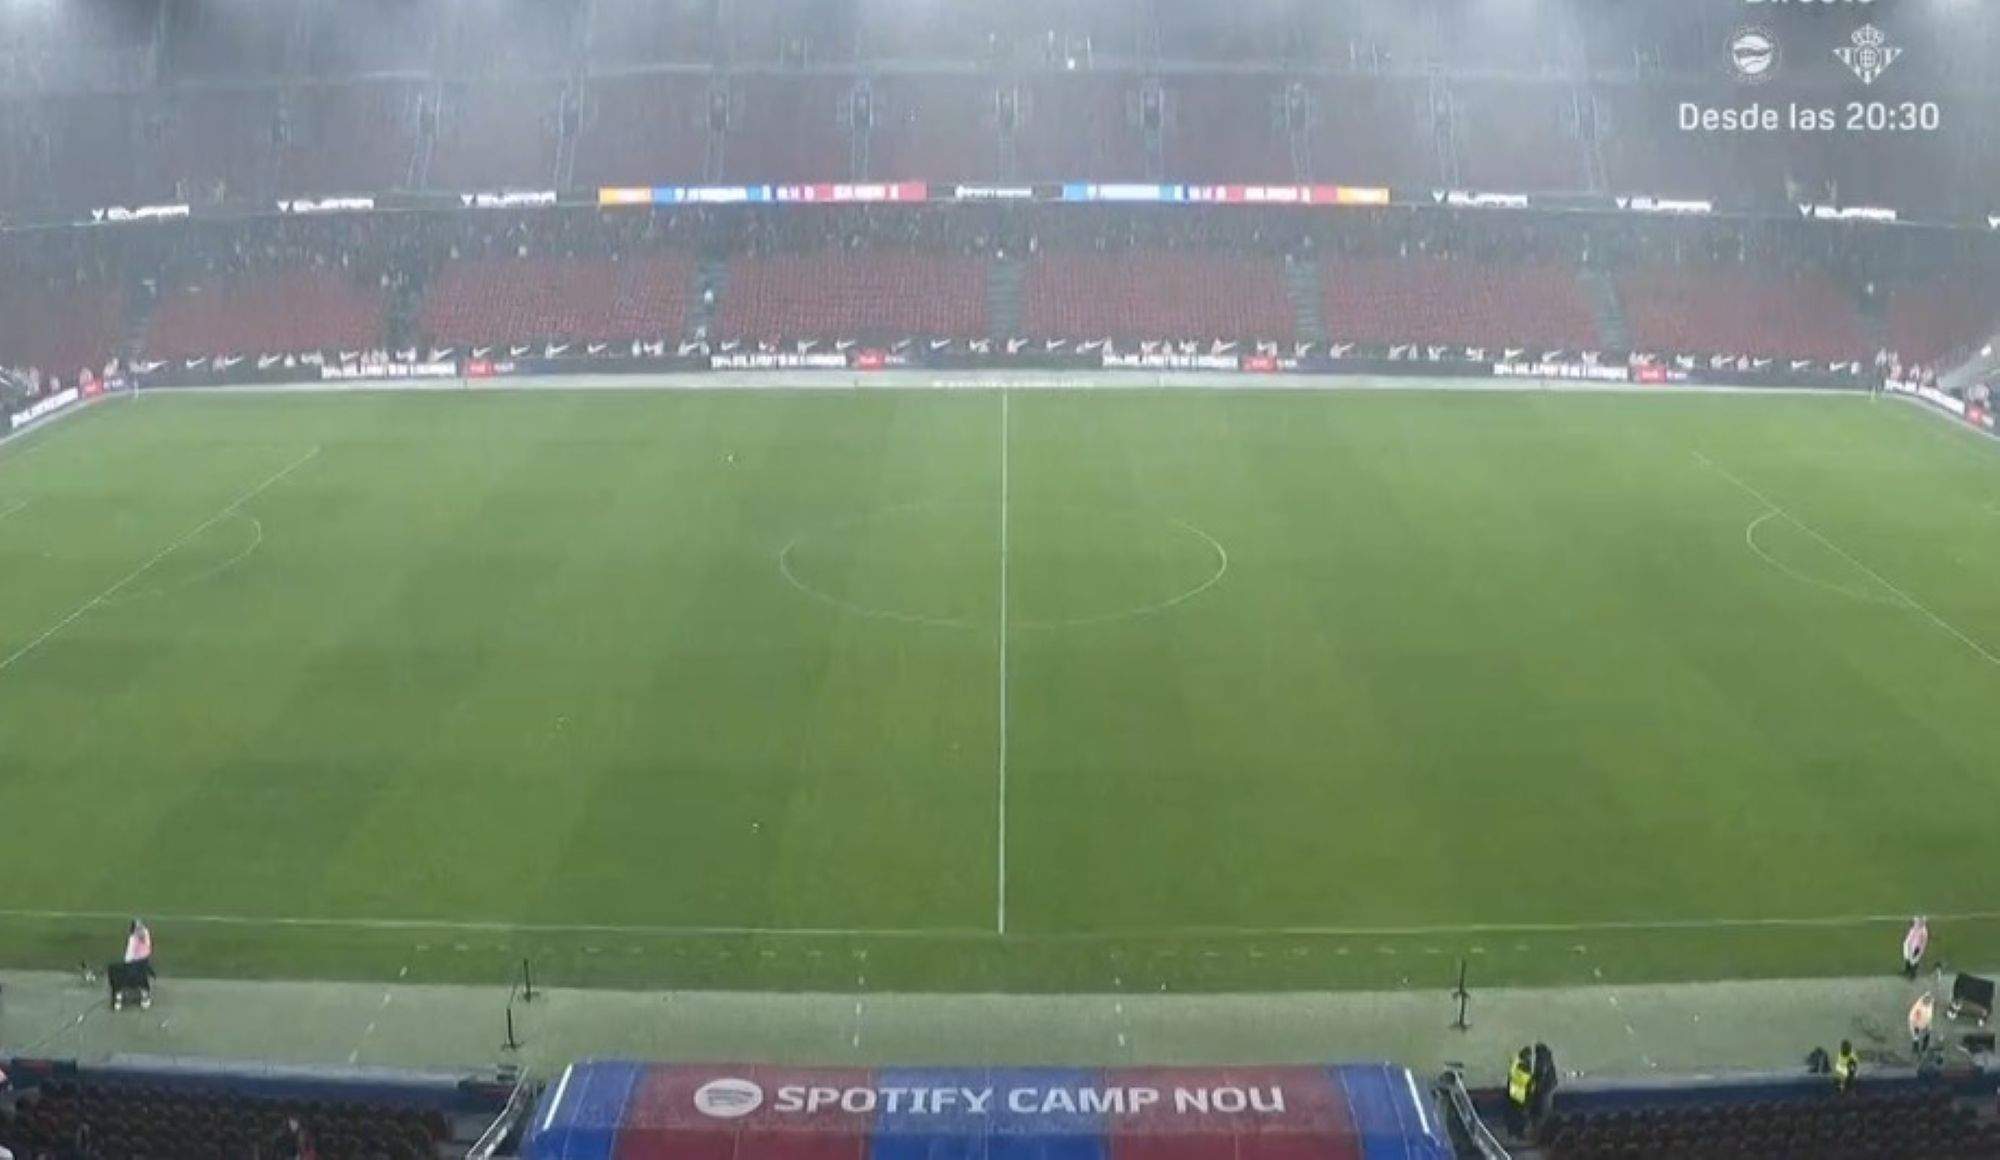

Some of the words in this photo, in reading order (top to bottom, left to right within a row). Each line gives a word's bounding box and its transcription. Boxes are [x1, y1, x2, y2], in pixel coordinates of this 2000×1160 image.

[774, 1087, 993, 1113] SPOTIFY
[1008, 1087, 1160, 1113] CAMP
[1174, 1086, 1286, 1113] NOU
